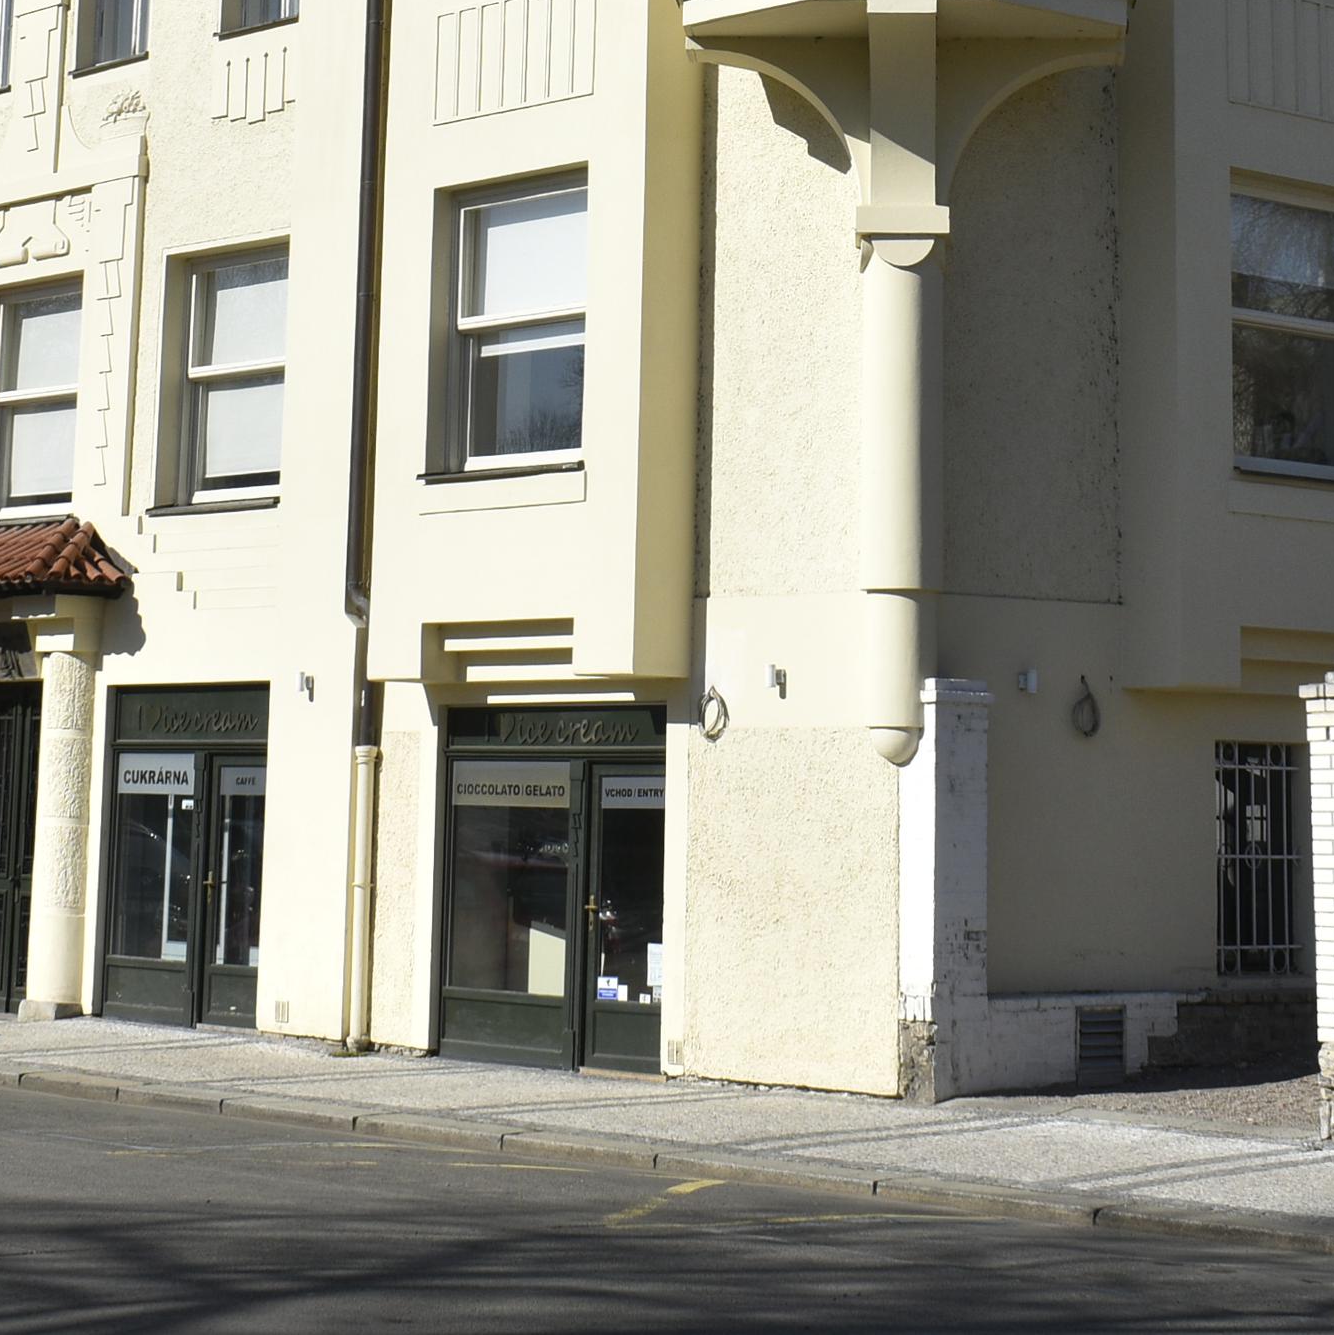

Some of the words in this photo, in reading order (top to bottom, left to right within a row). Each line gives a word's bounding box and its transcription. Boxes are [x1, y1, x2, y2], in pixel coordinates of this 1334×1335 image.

[194, 709, 259, 733] cream
[555, 718, 640, 744] cream
[123, 767, 189, 785] CUKRÁRNA
[456, 783, 521, 796] CIOCCOLATO
[525, 784, 566, 797] GELATO
[604, 788, 633, 798] VCHOD
[637, 788, 665, 798] ENTRY
